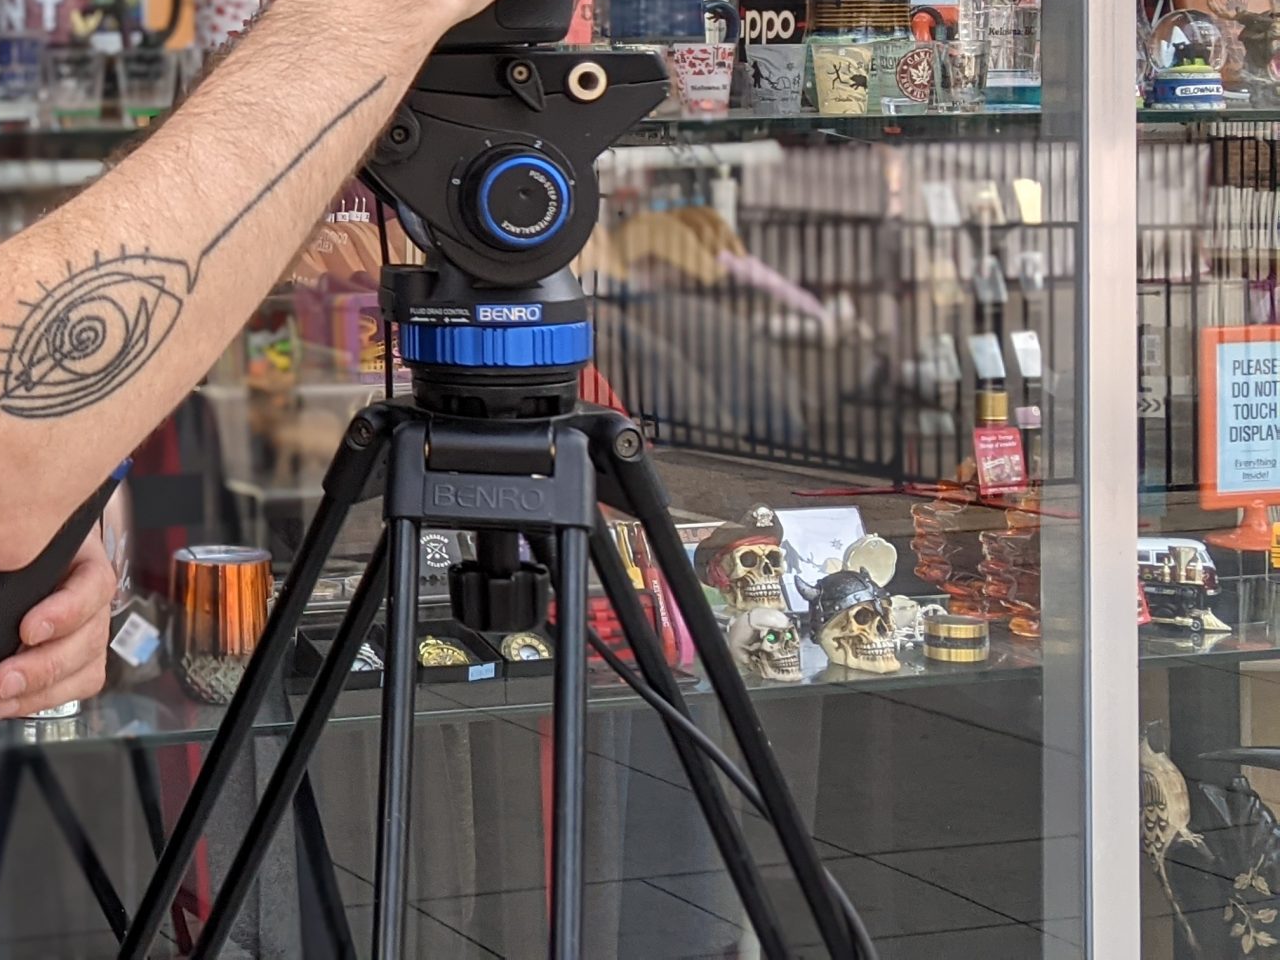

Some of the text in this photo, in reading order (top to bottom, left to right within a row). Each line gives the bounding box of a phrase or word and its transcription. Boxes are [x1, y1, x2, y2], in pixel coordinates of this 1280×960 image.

[739, 6, 796, 45] ippo
[534, 140, 542, 149] 2
[501, 200, 557, 234] COUNTERBALANCE
[480, 307, 540, 320] BENRO
[1232, 358, 1278, 376] PLEASE
[1232, 380, 1280, 398] DO NOT
[1233, 402, 1278, 420] TOUCH
[1229, 424, 1280, 443] DISPLAY
[1234, 458, 1278, 469] Everything
[1242, 470, 1270, 481] Inside!
[433, 483, 545, 512] BENRO
